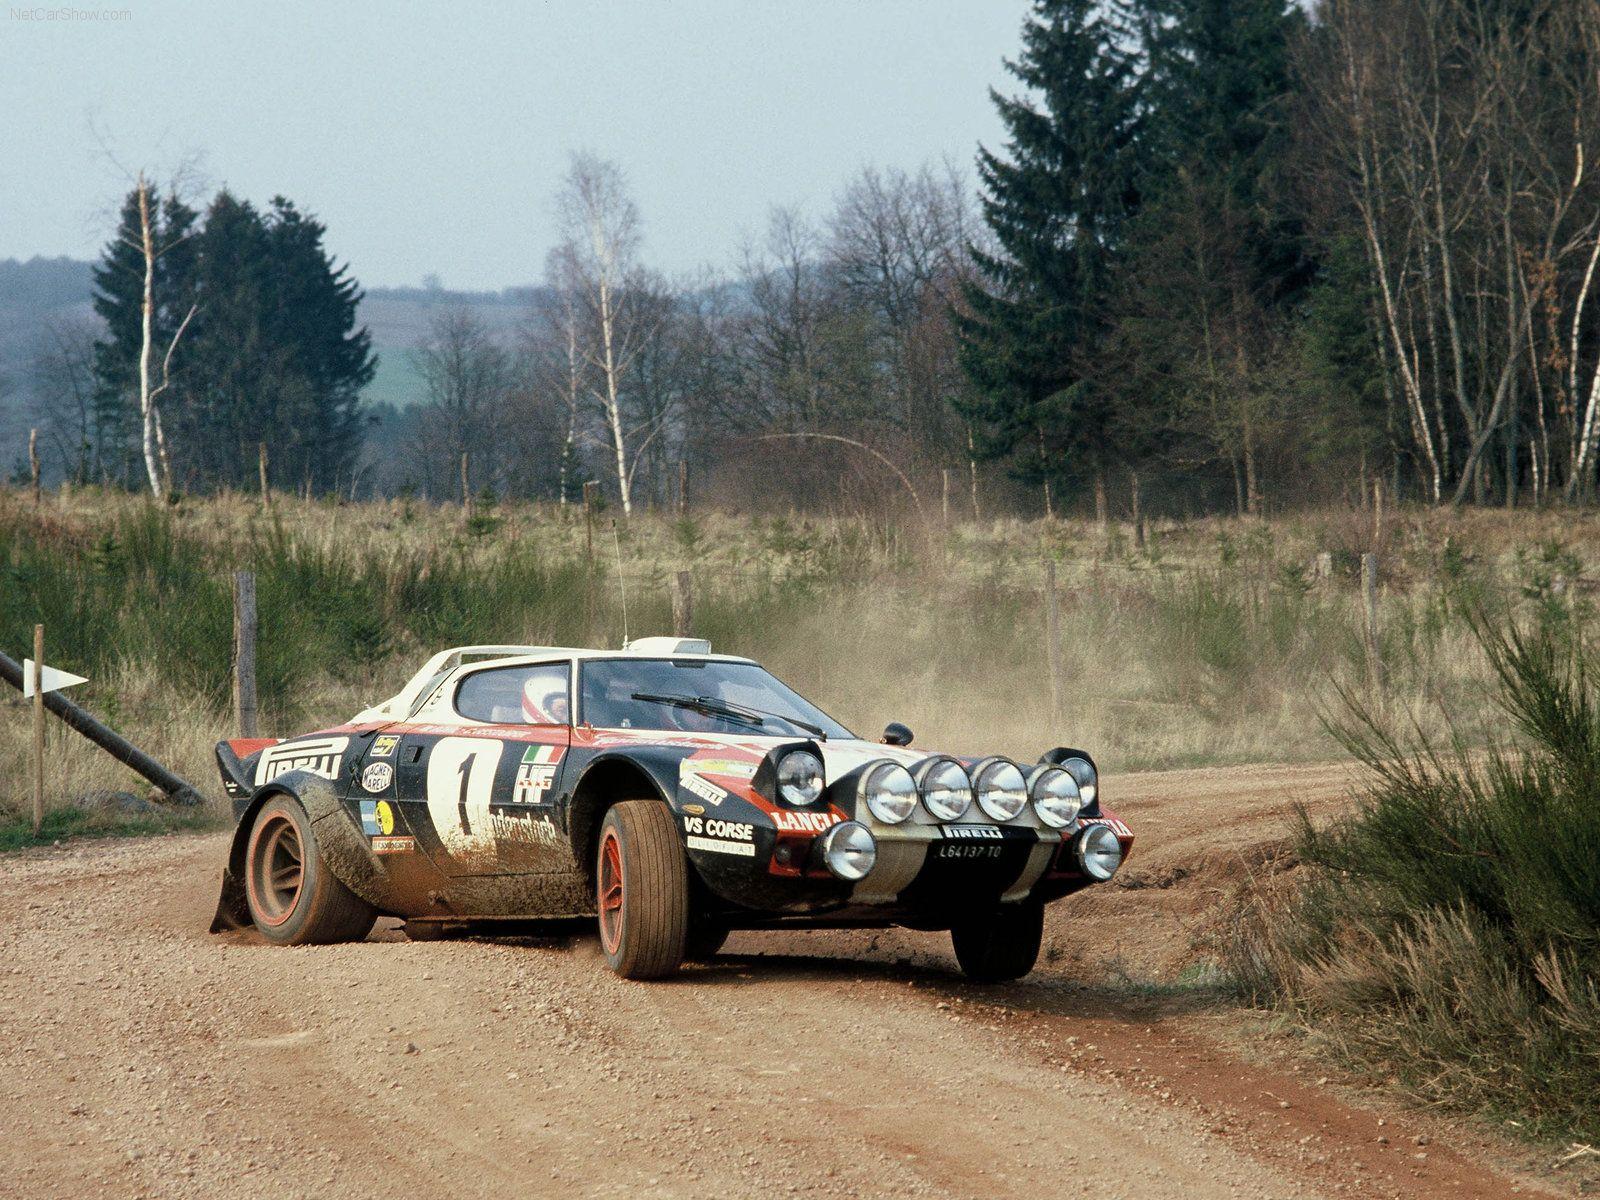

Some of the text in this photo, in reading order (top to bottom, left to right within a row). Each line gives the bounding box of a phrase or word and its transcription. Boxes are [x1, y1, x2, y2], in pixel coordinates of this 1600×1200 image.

[255, 736, 350, 787] PIRELLI
[457, 752, 478, 836] 1
[513, 764, 557, 804] HF
[680, 771, 728, 807] PIRELLI
[684, 816, 754, 841] VS CORSE
[770, 812, 842, 832] LANCIA
[942, 824, 1004, 839] PIRELLI
[987, 845, 1003, 858] TO
